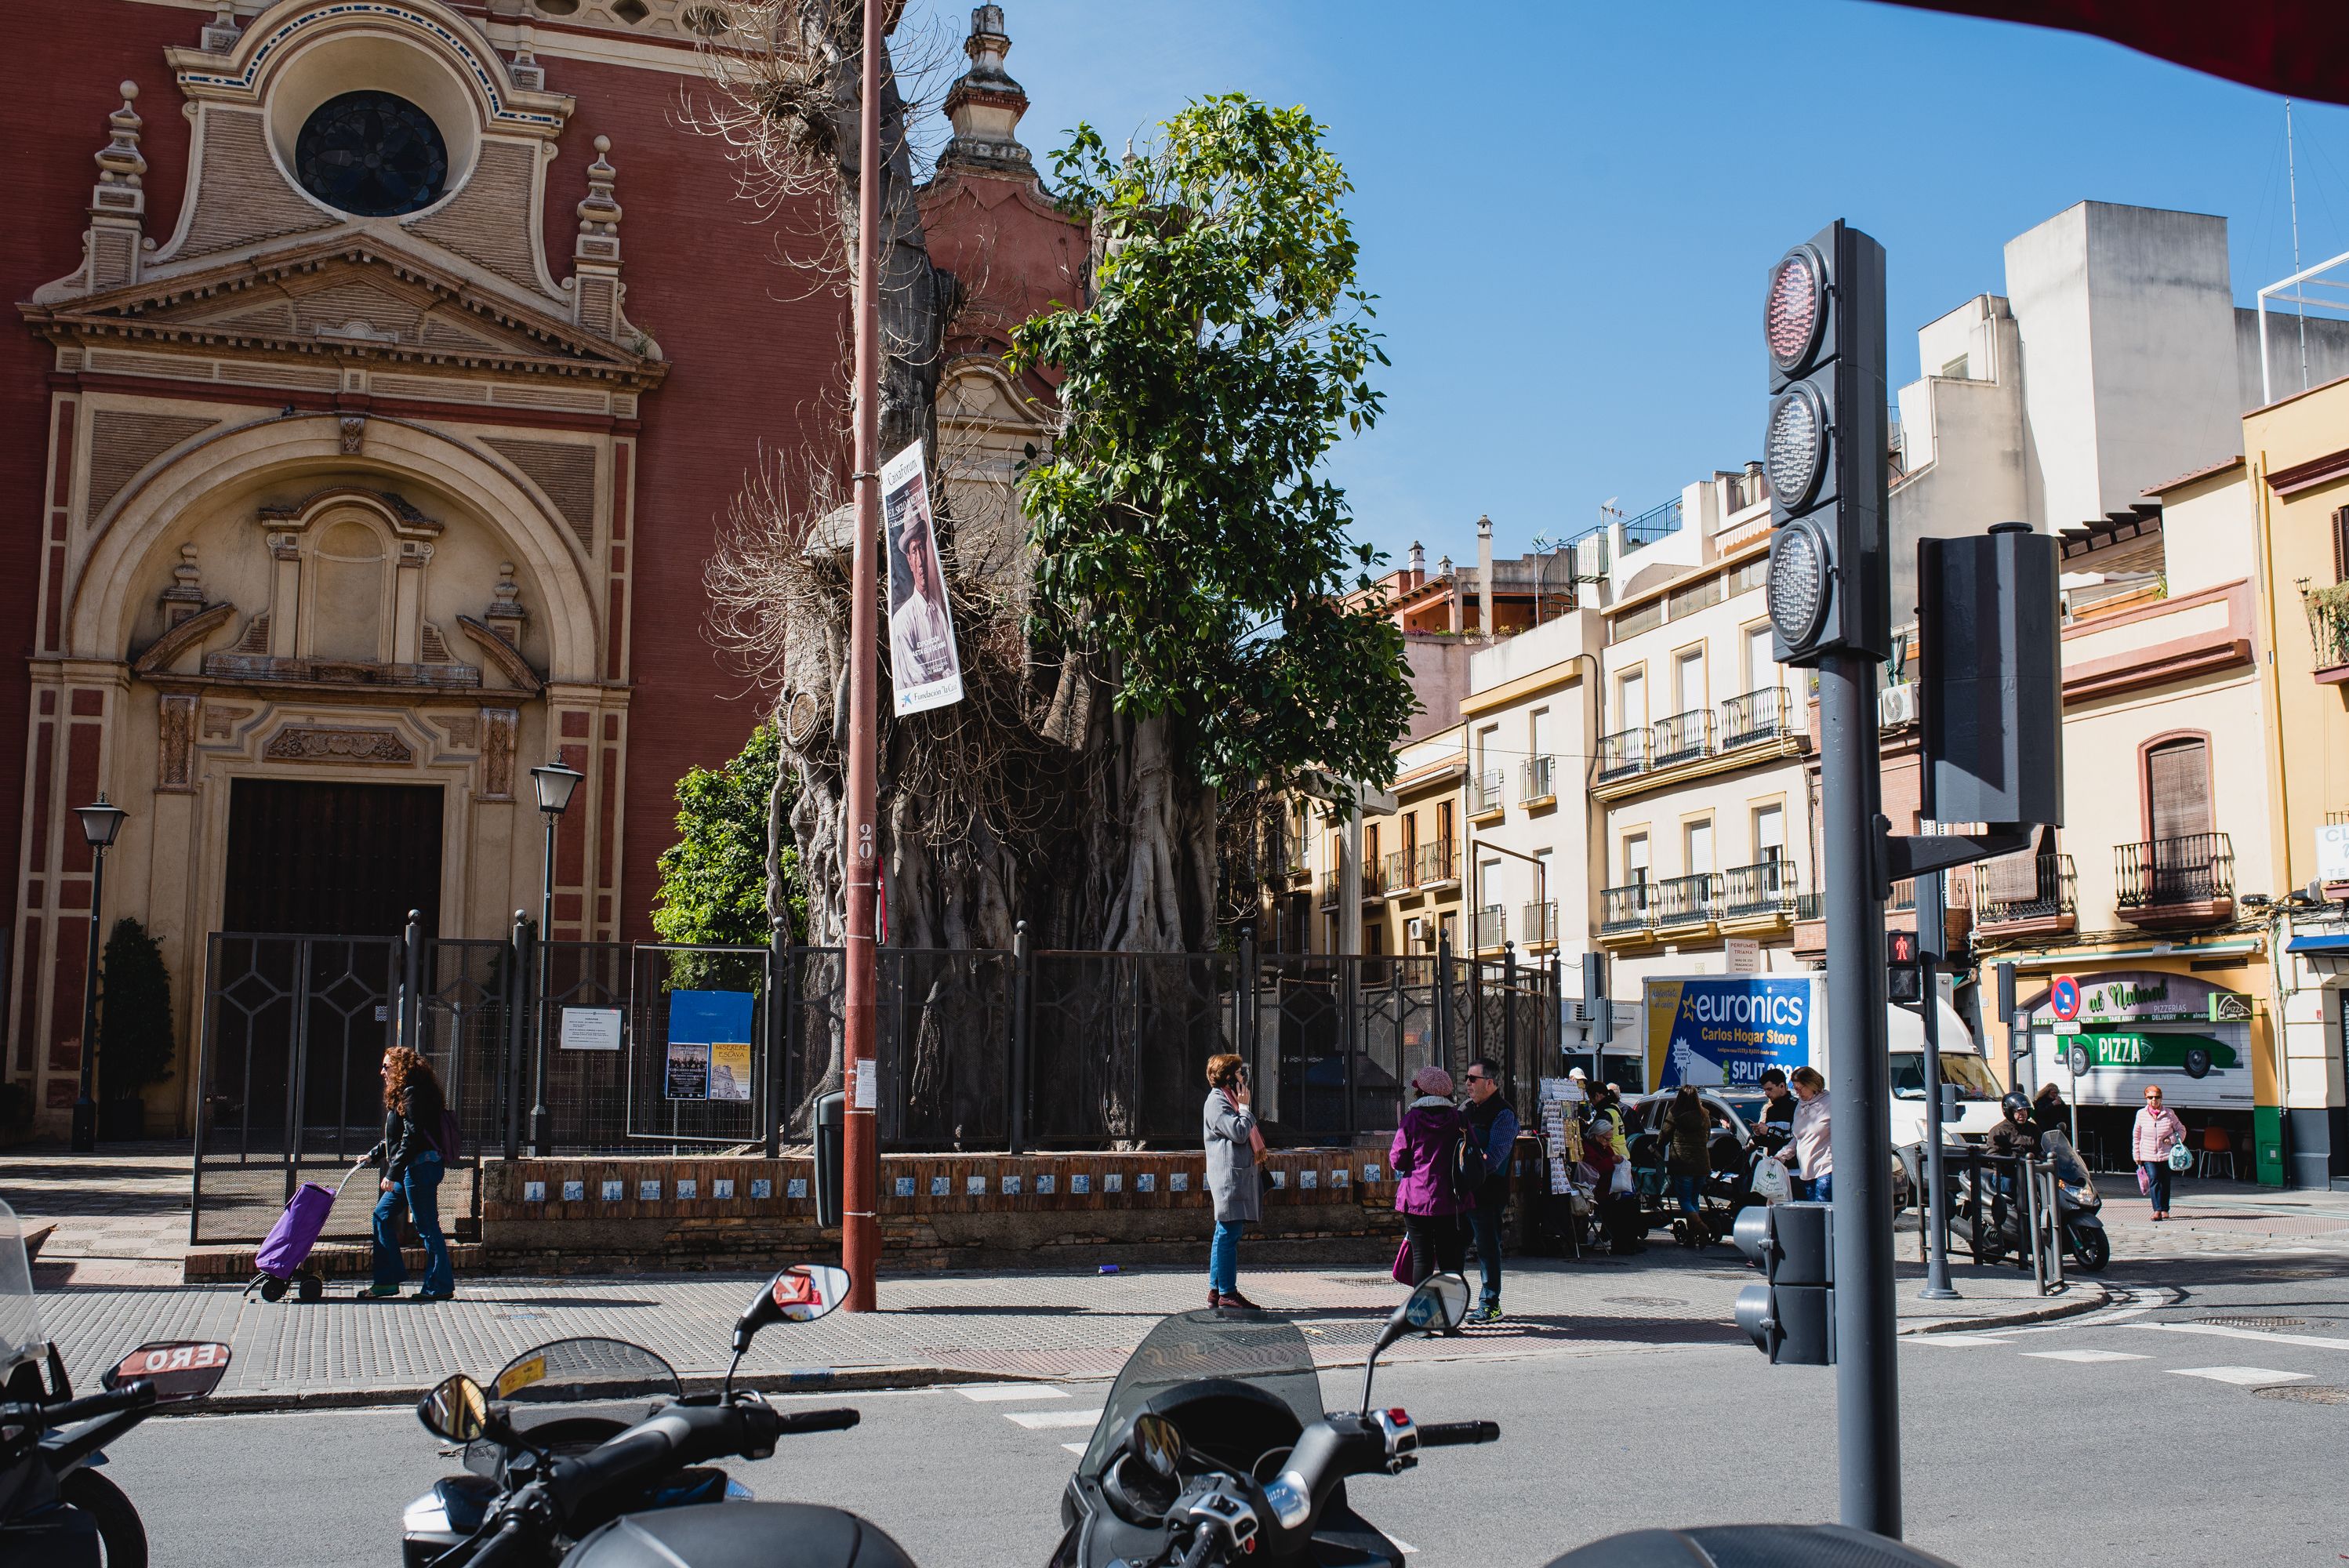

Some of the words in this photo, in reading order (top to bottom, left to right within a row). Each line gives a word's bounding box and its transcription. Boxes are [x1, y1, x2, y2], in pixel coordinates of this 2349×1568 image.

[888, 459, 917, 486] CaixaForum
[914, 688, 942, 701] Fundación
[2108, 978, 2168, 1010] Natural
[1697, 986, 1803, 1026] euronics
[2153, 1004, 2187, 1013] PIZZERÍAS
[1701, 1027, 1732, 1041] Carlos
[1734, 1028, 1764, 1046] Hogar
[1766, 1029, 1797, 1046] Store
[2099, 1037, 2140, 1062] PIZZA
[1732, 1061, 1765, 1080] SPLIT
